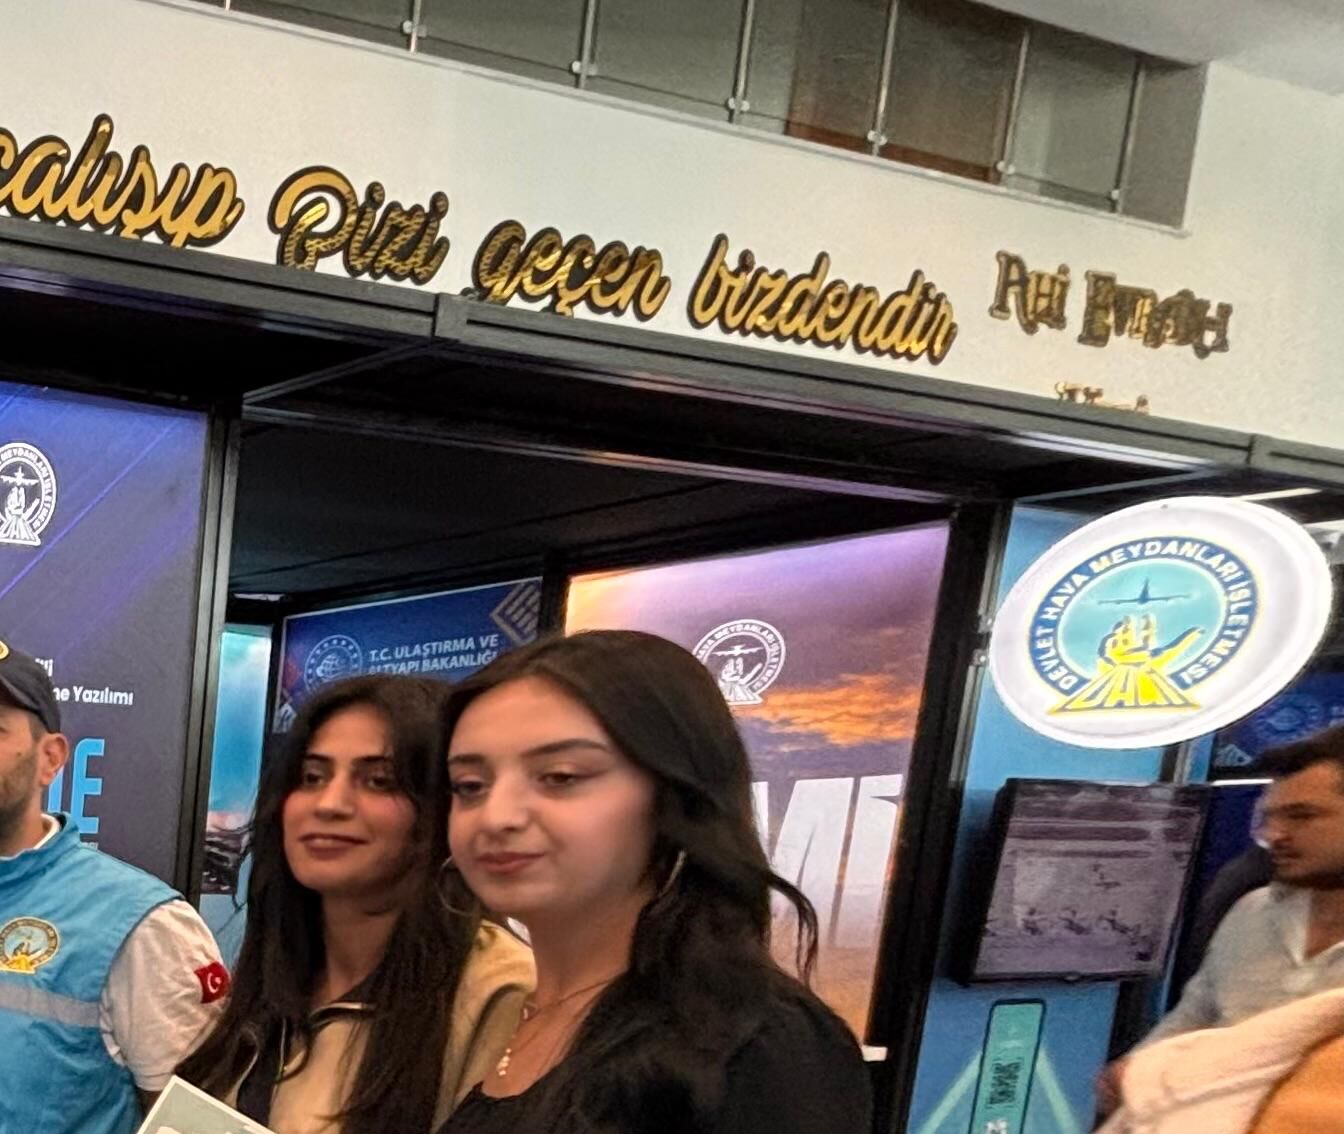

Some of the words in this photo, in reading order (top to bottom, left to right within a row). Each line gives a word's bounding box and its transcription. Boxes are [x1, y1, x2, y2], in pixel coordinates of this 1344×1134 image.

[688, 233, 959, 365] bizdendir
[1087, 539, 1244, 583] MEYDANLARI
[1043, 571, 1087, 620] HAVA
[395, 637, 476, 661] ULAŞTIRMA
[480, 634, 500, 648] VE
[1035, 628, 1079, 692] DEVLET
[73, 685, 134, 706] Yazılımı
